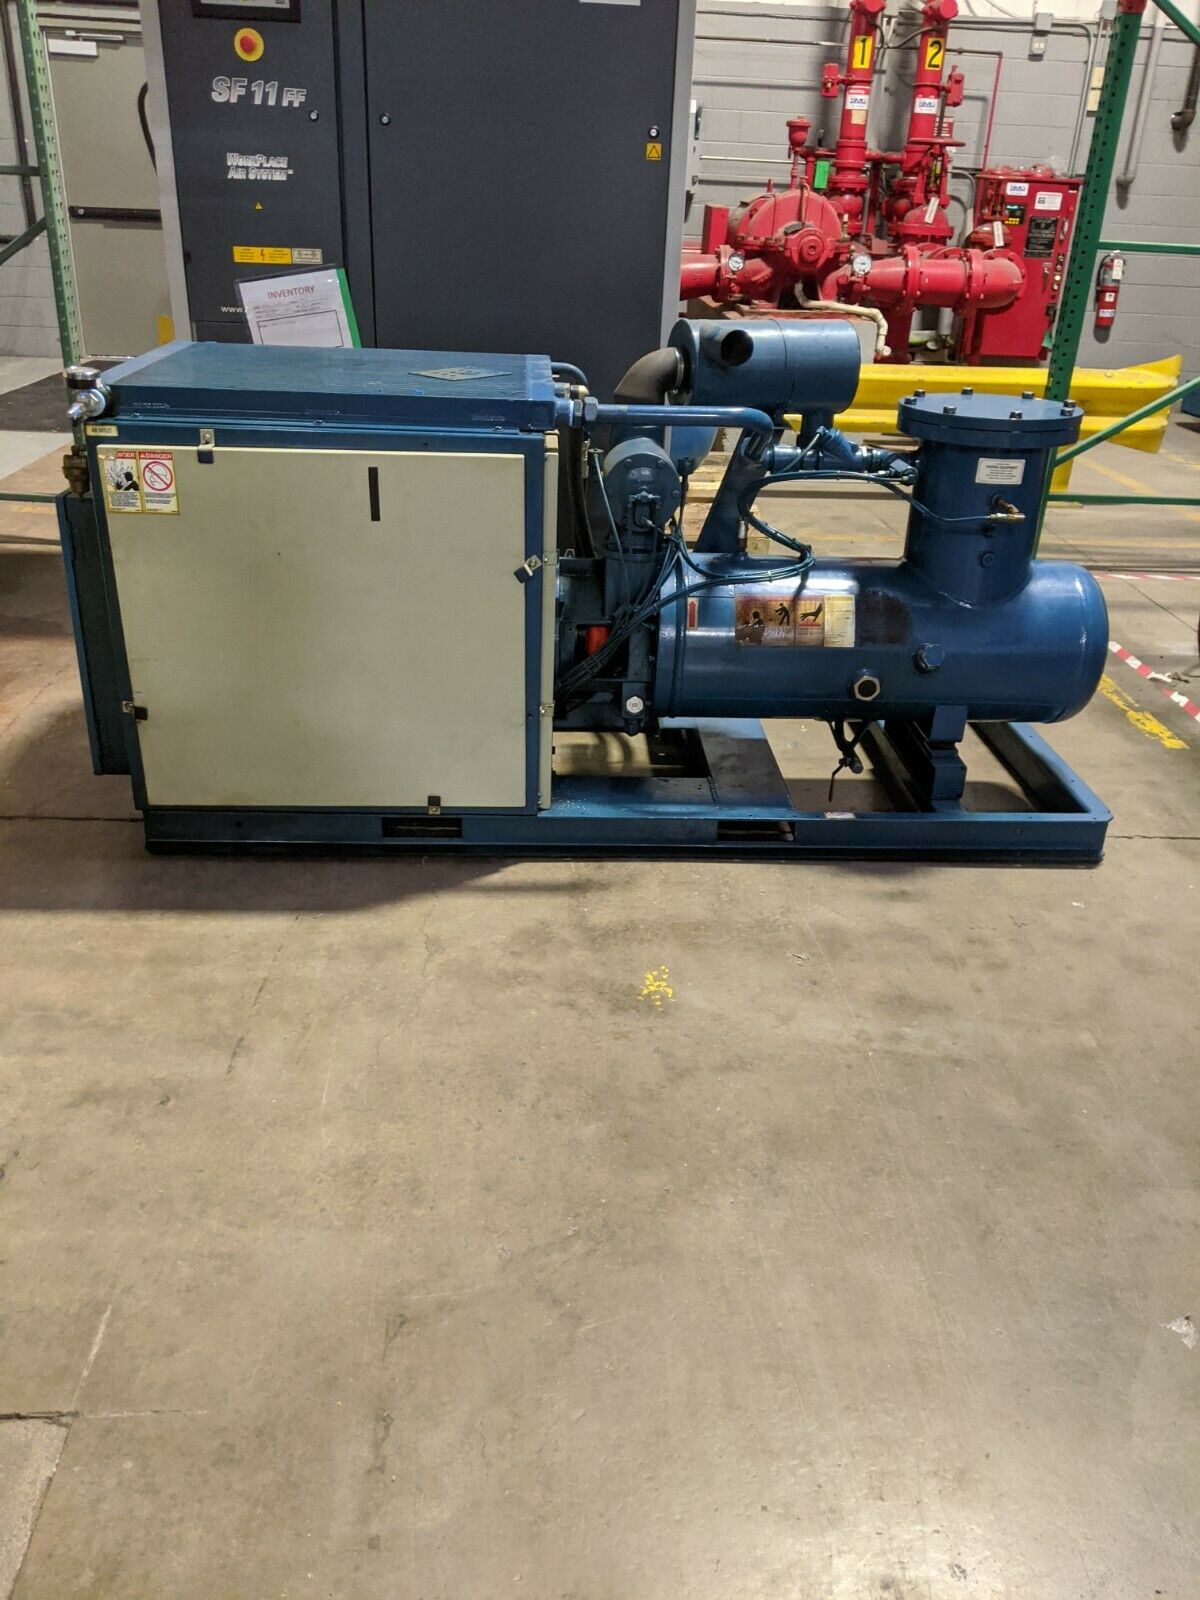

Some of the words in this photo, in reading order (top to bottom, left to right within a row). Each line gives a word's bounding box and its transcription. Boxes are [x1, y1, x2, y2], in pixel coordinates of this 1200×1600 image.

[860, 38, 868, 65] 1
[927, 40, 942, 68] 2
[211, 76, 248, 103] SF
[251, 80, 278, 106] 11
[282, 87, 307, 107] FF
[267, 285, 315, 299] INVENTORY
